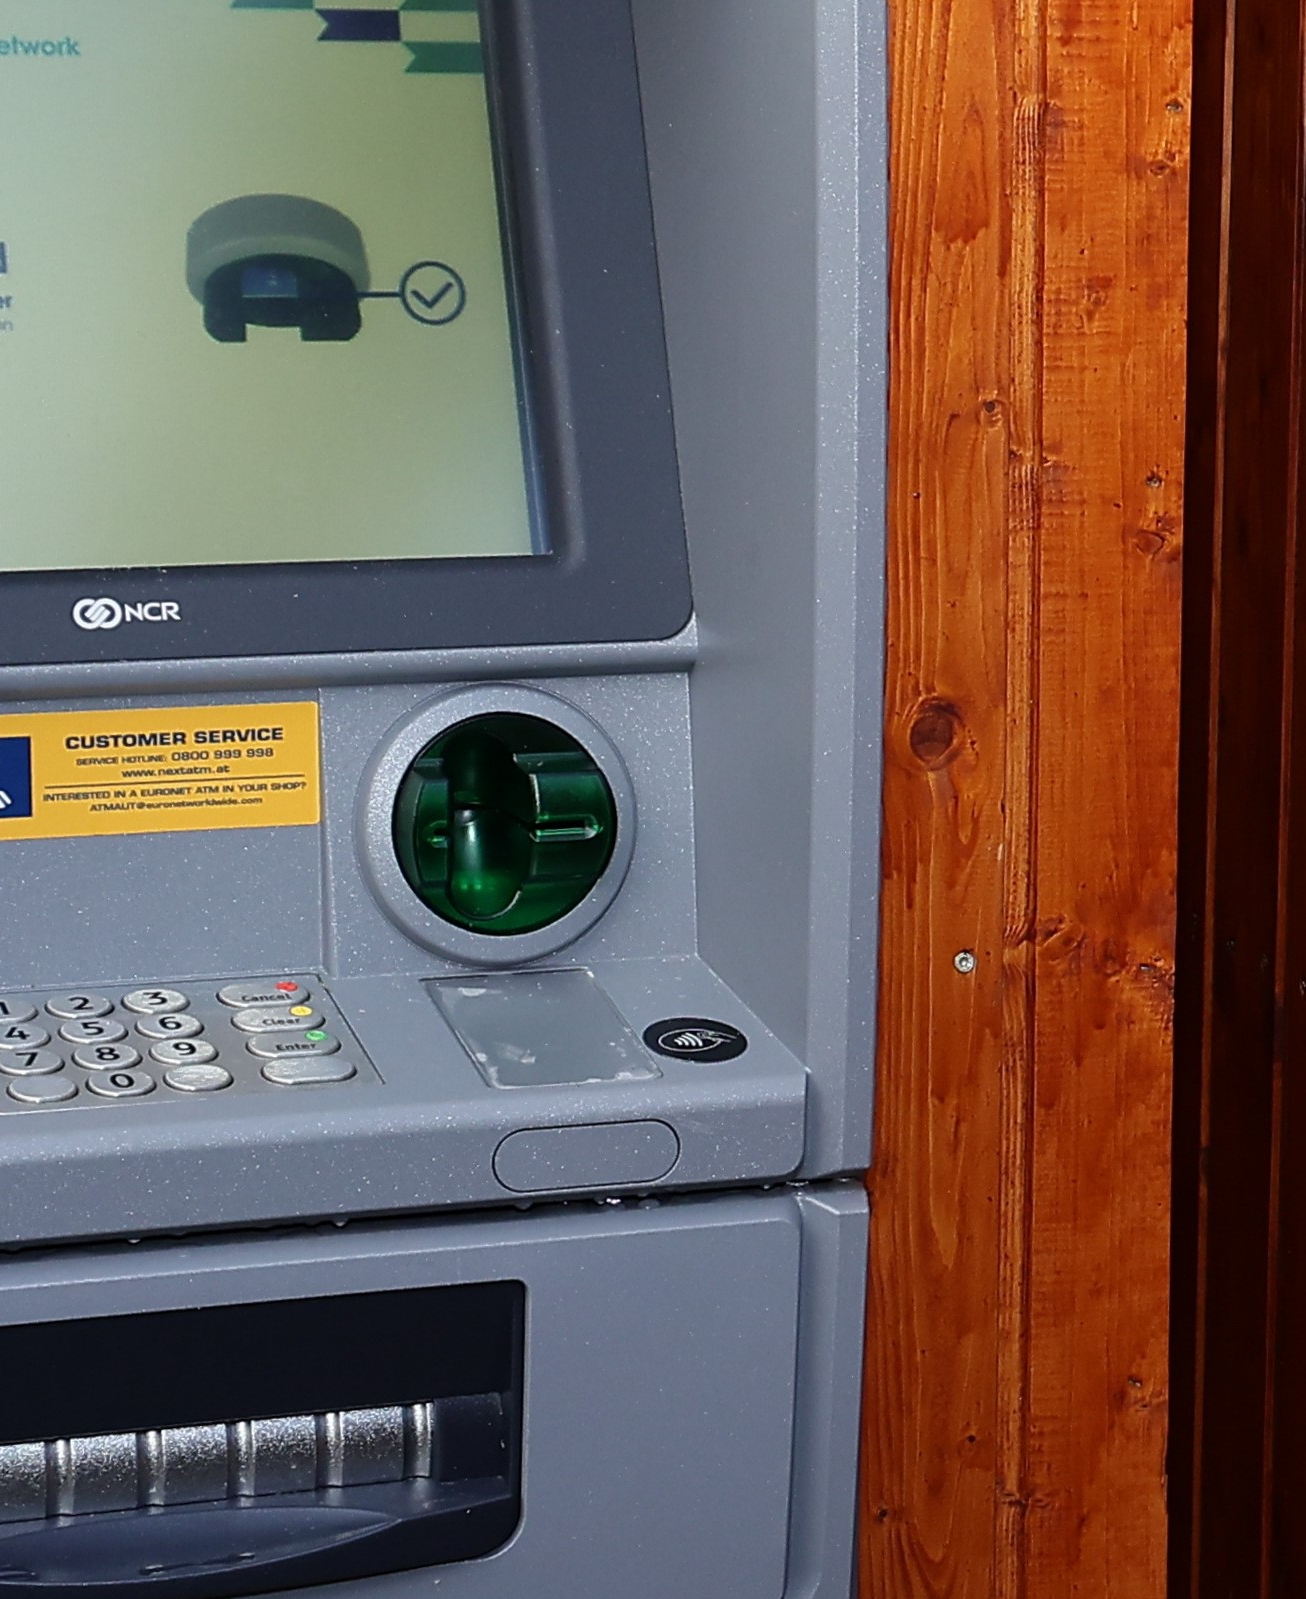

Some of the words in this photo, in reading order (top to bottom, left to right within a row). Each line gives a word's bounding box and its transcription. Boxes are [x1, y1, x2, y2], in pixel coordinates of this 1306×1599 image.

[124, 601, 182, 622] NCR
[64, 732, 187, 750] CUSTOMER
[193, 726, 284, 744] SERVICE
[75, 756, 120, 767] SERVICE
[170, 749, 210, 762] 0800
[213, 748, 242, 760] 999
[245, 746, 274, 758] 998
[120, 764, 231, 778] www.nextatm.at
[42, 790, 112, 802] INTERESTED
[113, 789, 126, 799] IN
[129, 788, 138, 798] A
[140, 786, 192, 798] EURONET
[195, 785, 220, 795] ATM
[222, 784, 235, 793] IN
[238, 782, 268, 793] YOUR
[270, 780, 307, 791] SHOP?
[68, 995, 95, 1012] 2
[142, 990, 169, 1006] 3
[241, 992, 294, 1002] Cancel
[4, 1026, 31, 1041] 4
[80, 1020, 106, 1036] 5
[158, 1015, 183, 1031] 6
[261, 1017, 301, 1027] Clear
[15, 1051, 40, 1067] 7
[94, 1045, 122, 1061] 8
[171, 1041, 198, 1056] 9
[275, 1041, 318, 1052] Enter
[109, 1072, 136, 1089] 0
